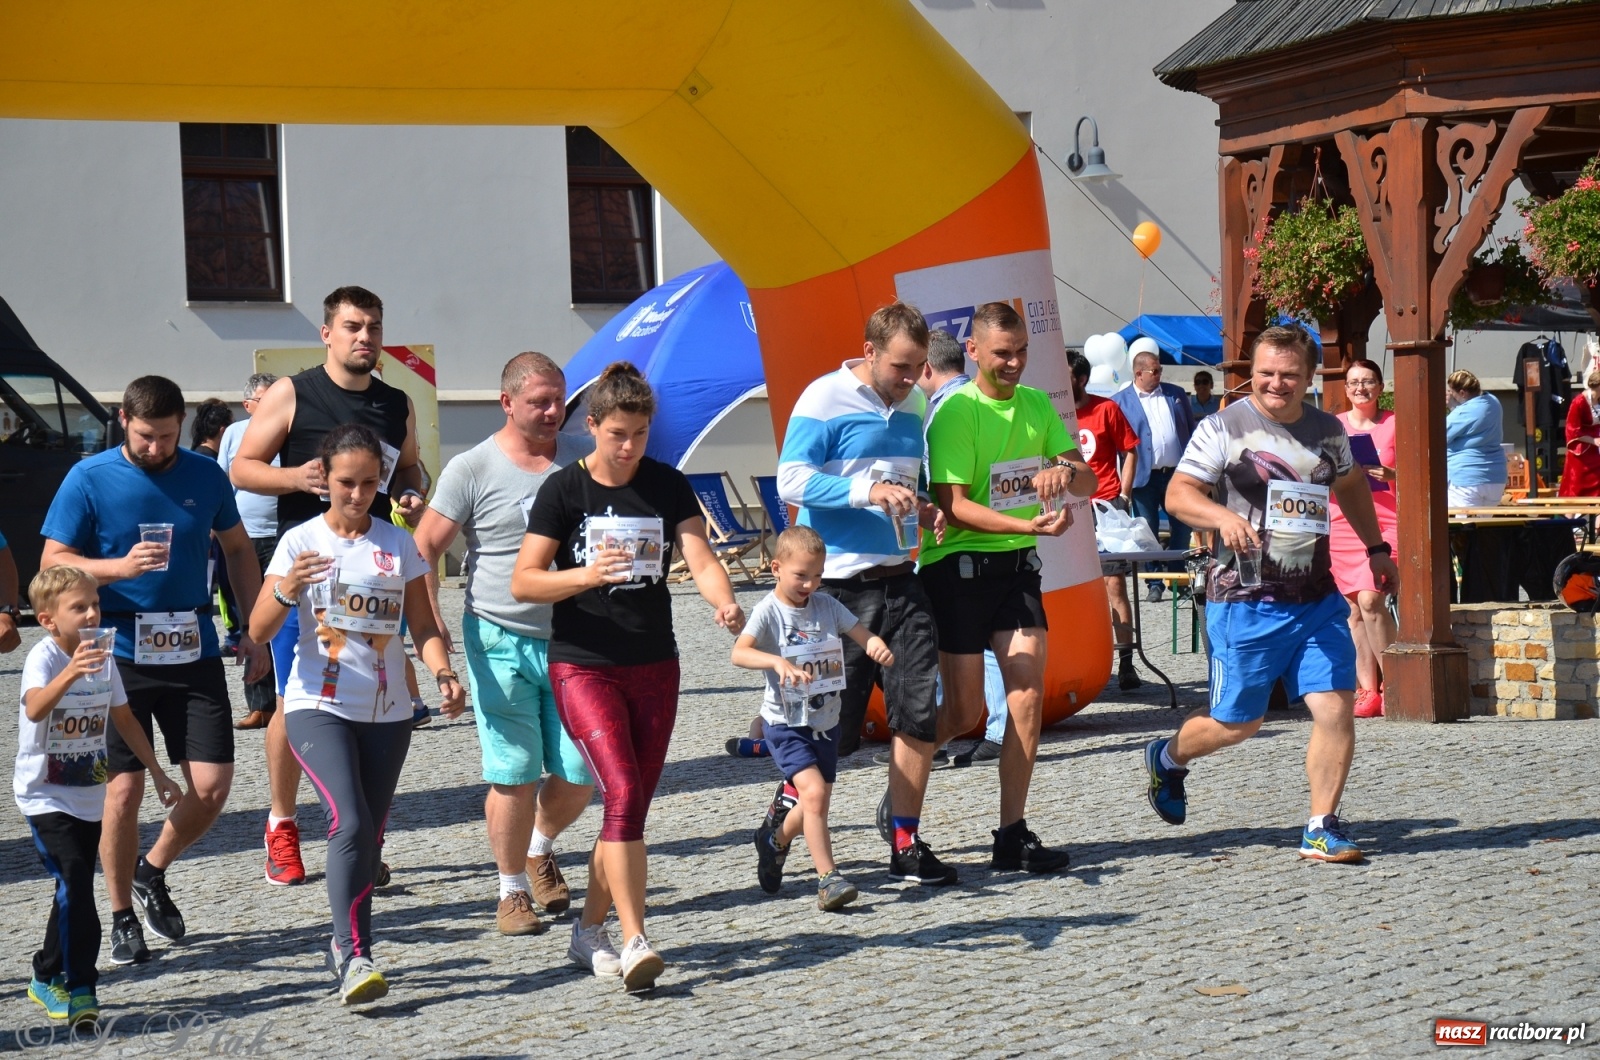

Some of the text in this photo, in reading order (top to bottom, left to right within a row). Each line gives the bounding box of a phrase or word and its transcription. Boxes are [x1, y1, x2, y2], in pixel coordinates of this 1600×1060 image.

[1001, 475, 1030, 494] 002
[1283, 498, 1318, 516] 003
[349, 594, 389, 616] 001
[153, 630, 193, 648] 005
[803, 658, 830, 676] 011
[64, 714, 99, 734] 006
